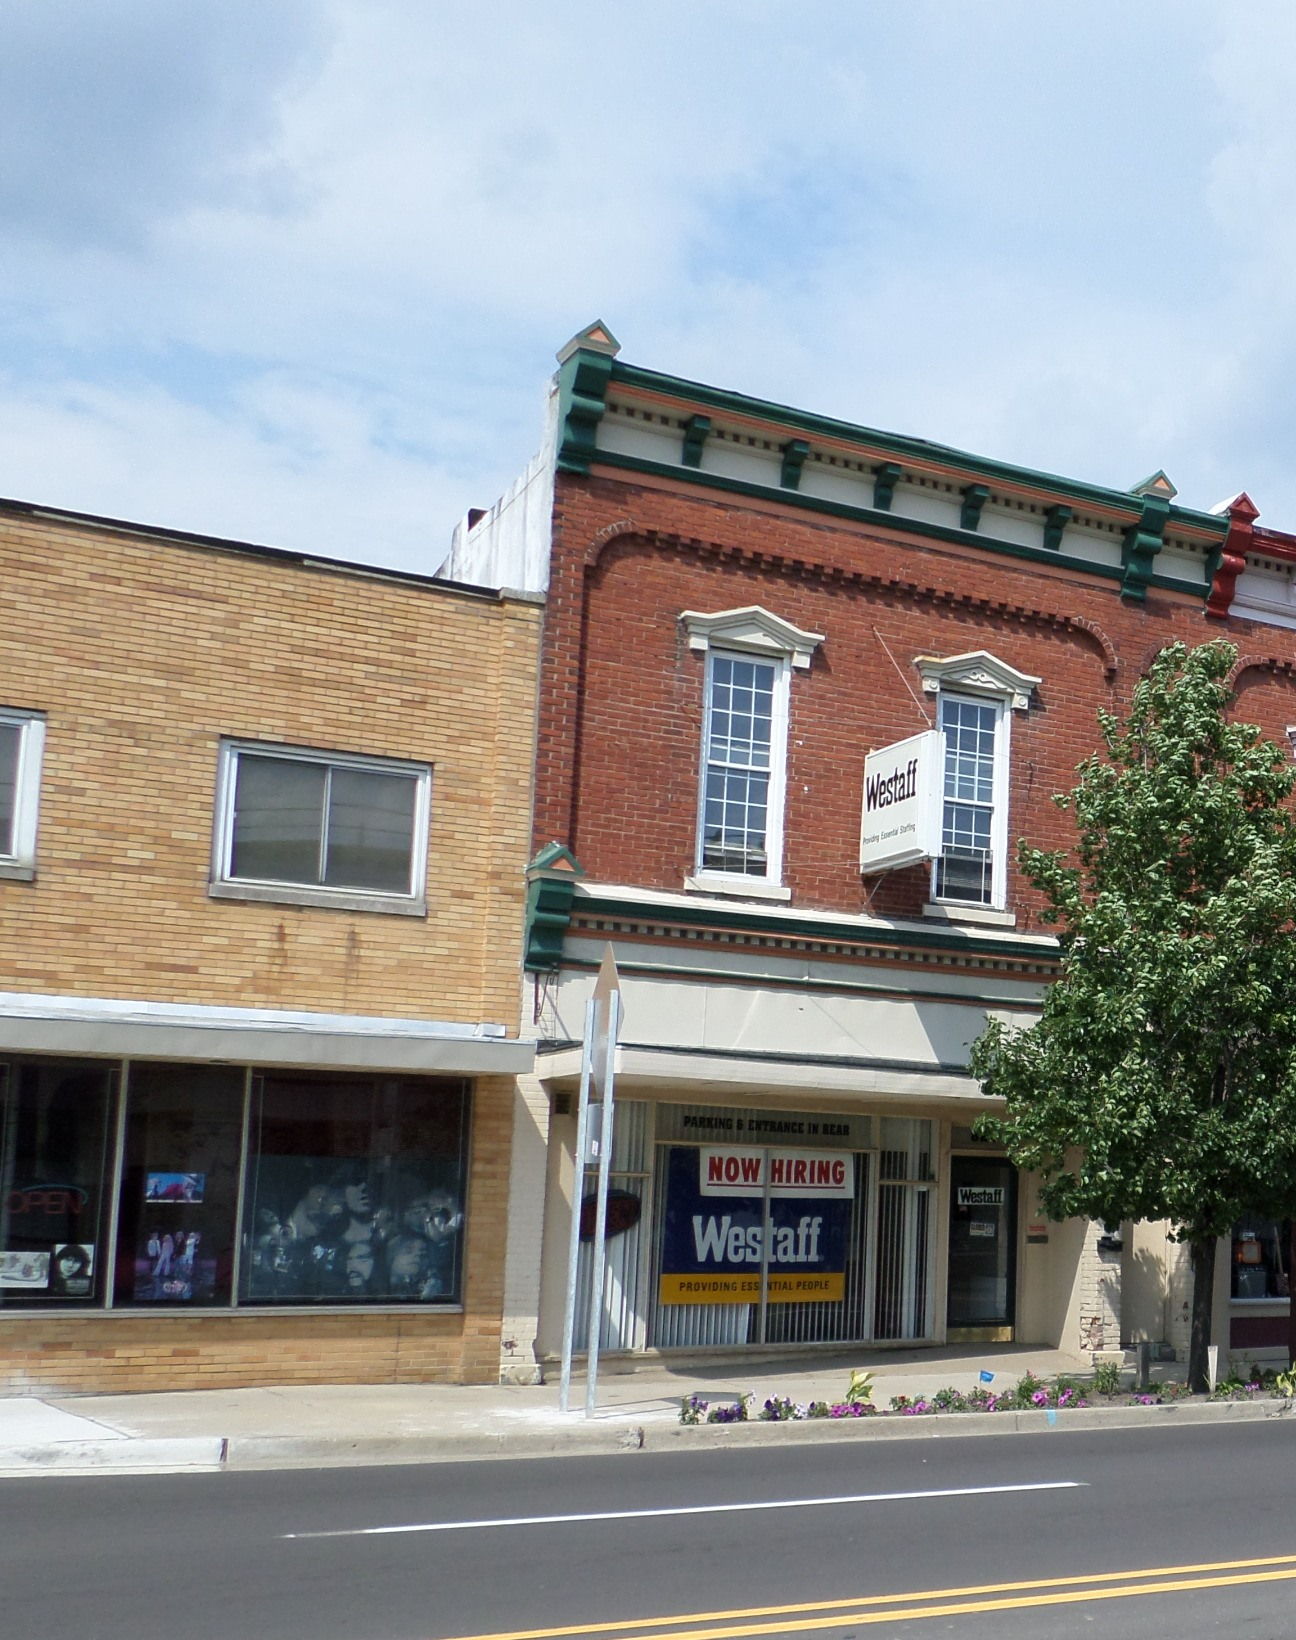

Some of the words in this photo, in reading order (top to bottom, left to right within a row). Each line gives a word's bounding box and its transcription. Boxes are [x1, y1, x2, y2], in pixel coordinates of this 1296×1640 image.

[866, 758, 918, 812] Westaff
[684, 1115, 733, 1131] PARKING
[748, 1119, 804, 1134] ENTRANCE
[807, 1123, 819, 1135] IN
[822, 1124, 850, 1136] REAR
[708, 1156, 761, 1183] NOW
[770, 1158, 845, 1185] HIRING
[8, 1190, 82, 1213] OPEN
[960, 1188, 1003, 1204] Westaff
[692, 1215, 823, 1263] Westaff
[679, 1281, 737, 1292] PROVIDING
[741, 1280, 793, 1291] ESSNTIAL
[796, 1279, 830, 1291] PEOPLE
